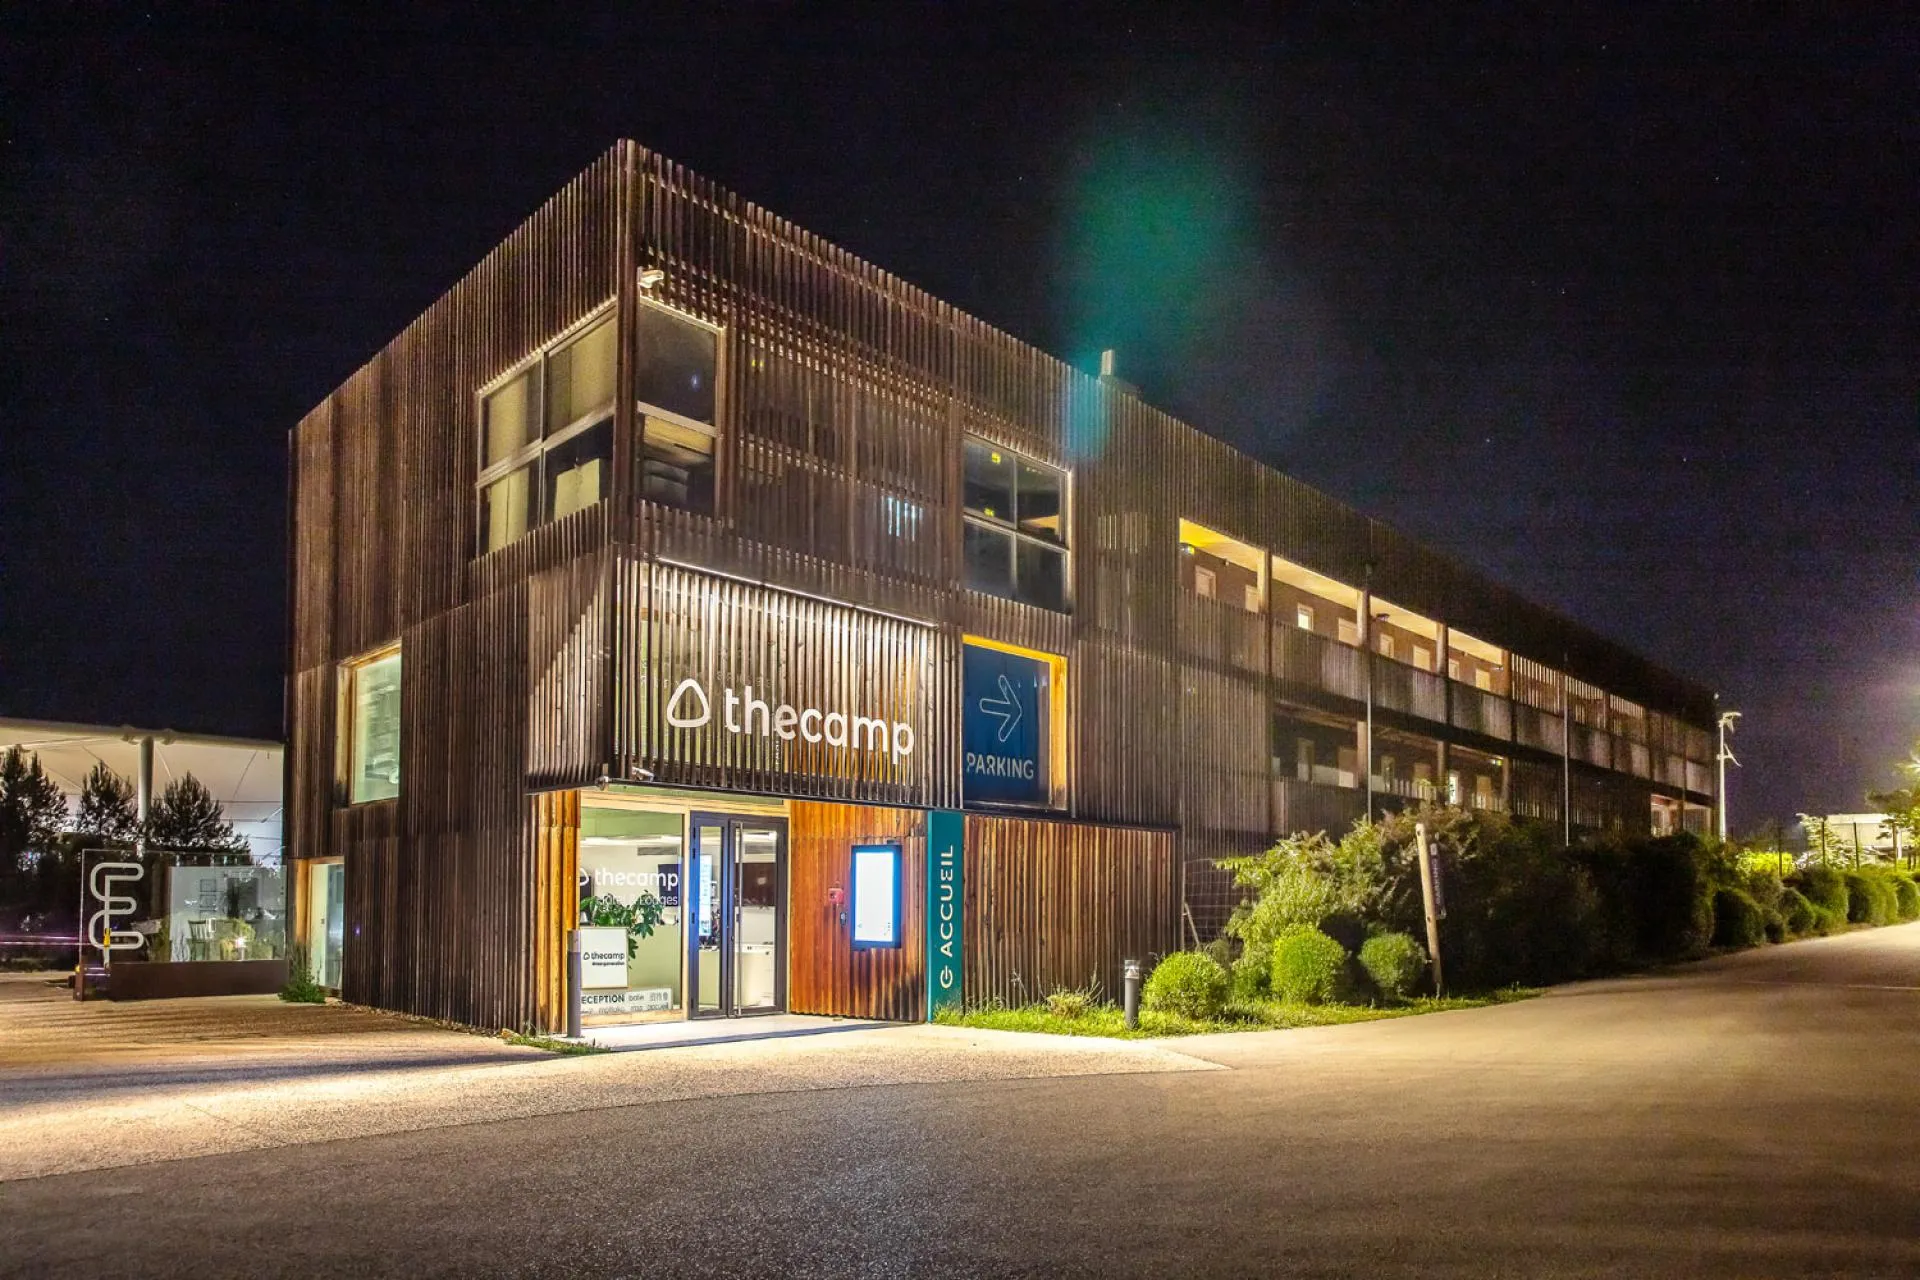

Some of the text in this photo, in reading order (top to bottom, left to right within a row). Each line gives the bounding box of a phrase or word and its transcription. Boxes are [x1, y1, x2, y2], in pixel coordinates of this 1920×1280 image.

[724, 686, 915, 765] thecamp
[966, 752, 1034, 780] PARKING
[594, 867, 679, 891] thecamp
[940, 845, 953, 957] ACCUEIL
[591, 952, 625, 960] thecamp
[581, 994, 625, 1004] ECEPTION
